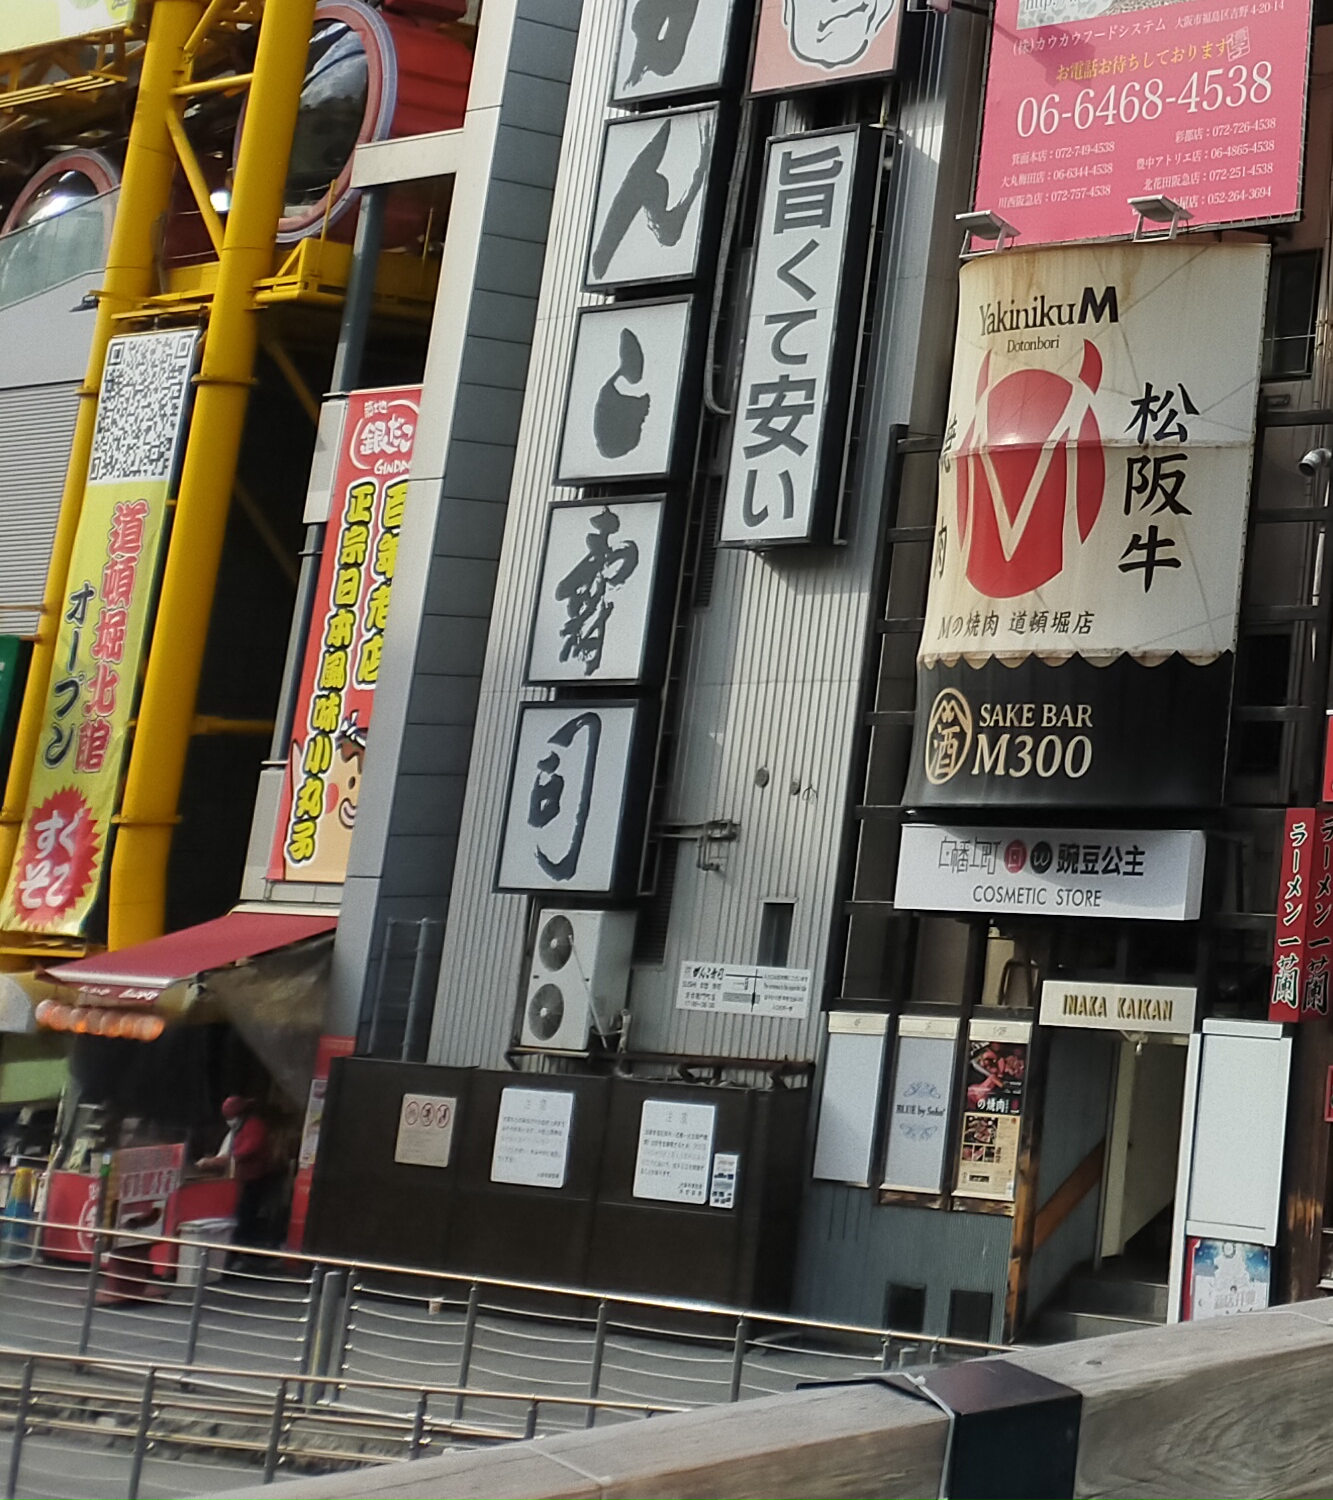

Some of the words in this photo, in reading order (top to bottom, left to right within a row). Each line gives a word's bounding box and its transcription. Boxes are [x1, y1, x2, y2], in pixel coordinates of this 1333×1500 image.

[1015, 60, 1273, 138] 06-6468-4538
[742, 144, 844, 529] 旨くて安い
[1006, 334, 1061, 355] Dotonbori
[1118, 382, 1201, 594] 松阪牛
[75, 499, 149, 773] 道頓堀北館
[1007, 609, 1096, 636] 道頓堀店
[43, 581, 96, 769] オープン
[286, 482, 376, 862] 正宗日本風味小丸子
[978, 703, 1037, 729] SAKE
[1041, 704, 1094, 729] BAR
[970, 733, 1094, 779] M300
[34, 808, 85, 853] すぐ
[1055, 843, 1146, 877] 豌豆公主
[18, 862, 72, 909] そこ
[972, 885, 1048, 906] COSMETIC
[1055, 888, 1102, 908] STORE
[1063, 993, 1108, 1018] INAKA
[1117, 997, 1174, 1022] KAIKAN
